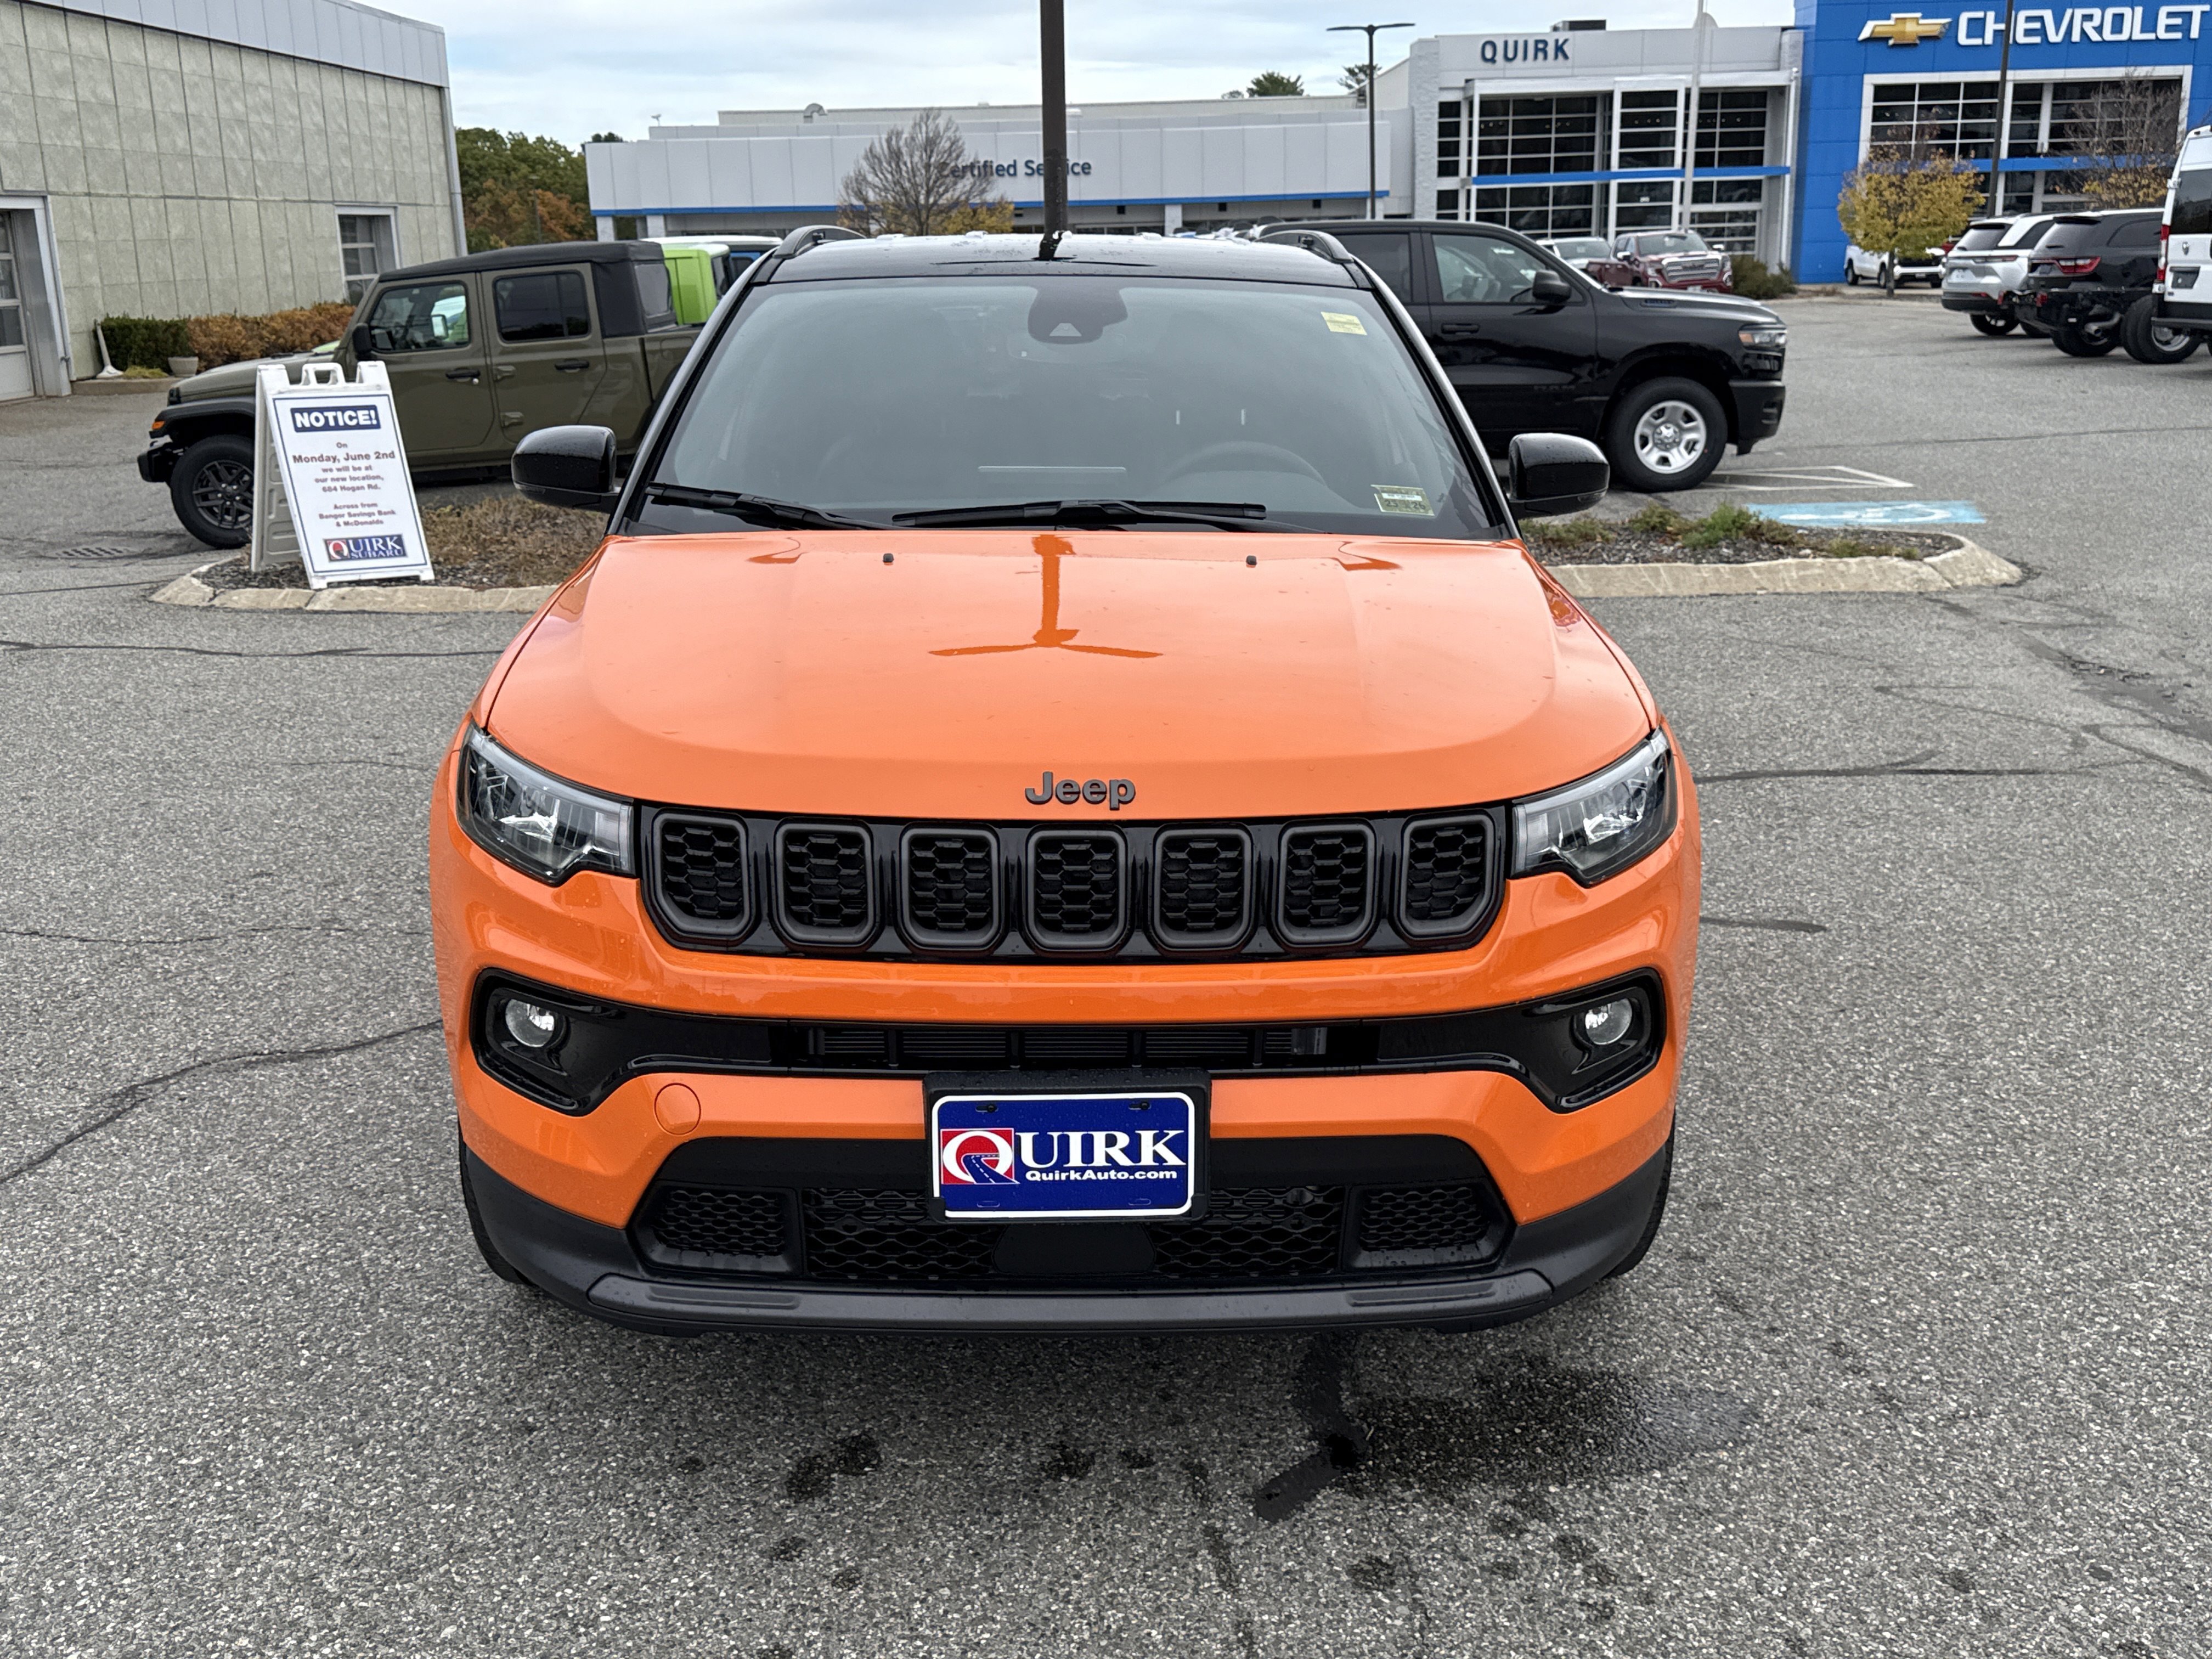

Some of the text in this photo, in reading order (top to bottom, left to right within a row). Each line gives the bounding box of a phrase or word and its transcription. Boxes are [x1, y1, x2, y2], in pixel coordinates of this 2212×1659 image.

[1957, 4, 2210, 45] CHEVROLET
[1480, 38, 1570, 64] QUIRK
[1024, 160, 1092, 176] Seice
[294, 410, 377, 428] NOTICE!
[293, 450, 395, 464] Monday, June 2nd
[340, 484, 365, 493] Hogan
[329, 535, 402, 559] QUIRK
[351, 549, 403, 559] SUBARU
[1025, 771, 1136, 811] Jeep
[943, 1130, 1186, 1184] QUIRK
[1025, 1169, 1177, 1182] QuirkAuto.com
